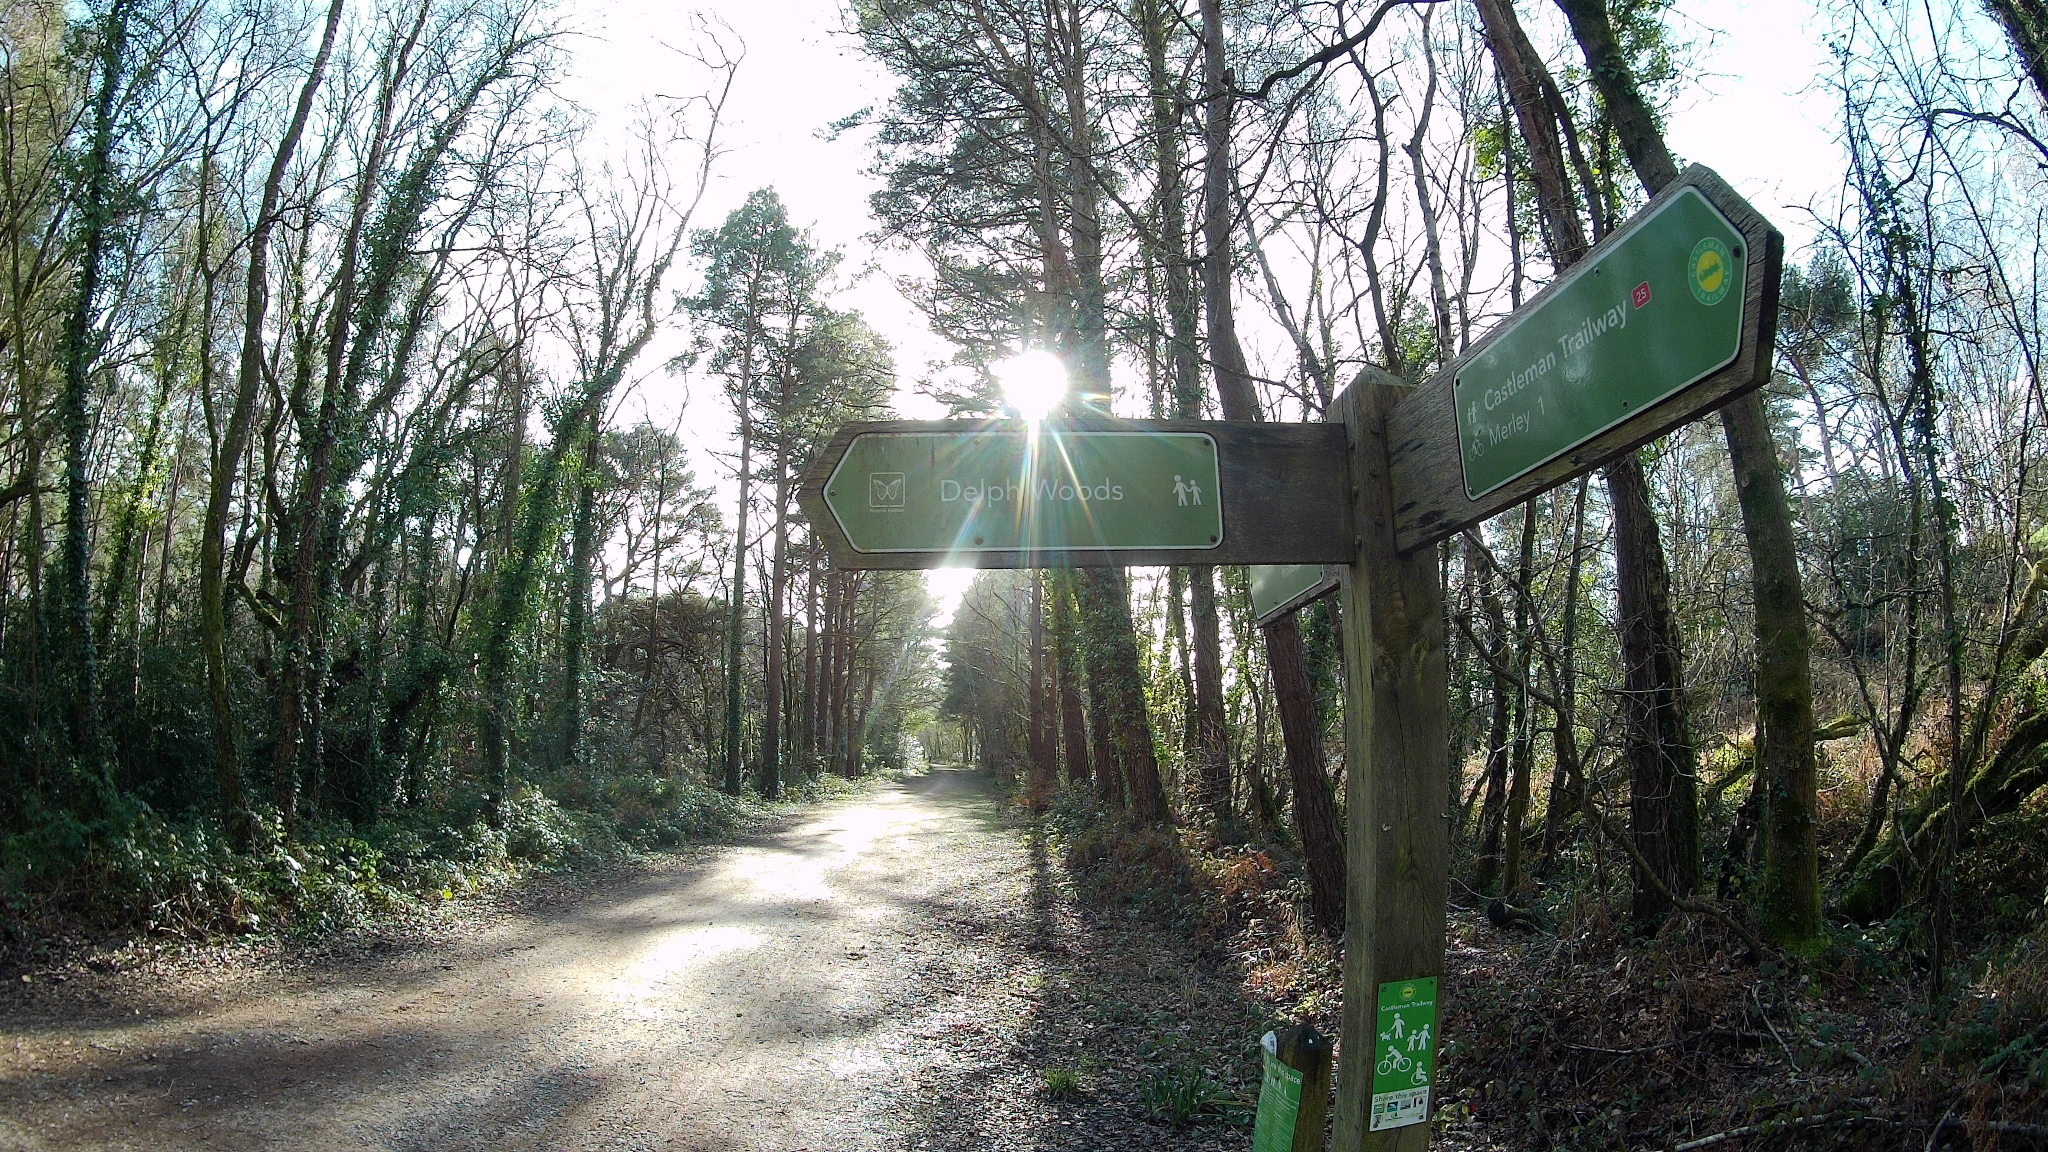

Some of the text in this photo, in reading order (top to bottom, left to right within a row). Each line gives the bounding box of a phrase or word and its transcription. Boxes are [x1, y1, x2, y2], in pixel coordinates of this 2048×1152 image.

[1636, 288, 1647, 303] 25
[1484, 300, 1627, 411] Castleman Trailway
[1489, 396, 1545, 447] Merley 1
[940, 478, 1124, 508] Delph Woods
[1381, 1000, 1433, 1012] Castleman Trailway
[1374, 1095, 1393, 1103] Share
[1409, 1090, 1427, 1098] space
